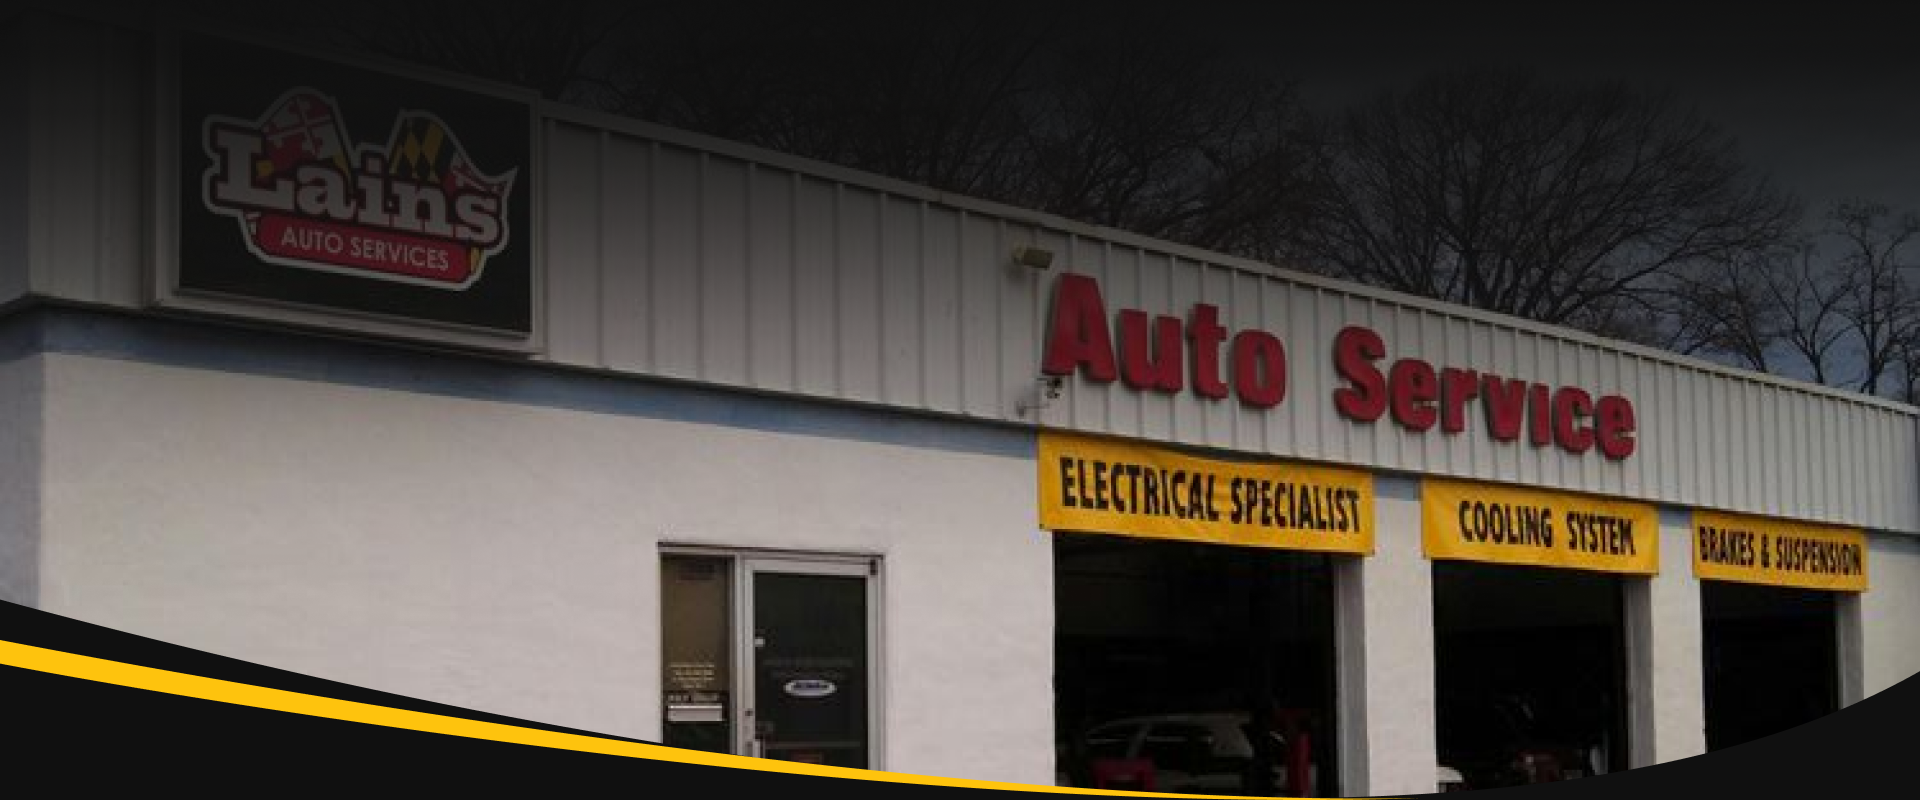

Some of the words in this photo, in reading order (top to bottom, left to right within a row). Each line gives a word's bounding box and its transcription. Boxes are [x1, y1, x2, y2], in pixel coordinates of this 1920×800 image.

[216, 129, 500, 244] Lains
[281, 226, 344, 254] AUTO
[350, 237, 450, 271] SERVICES
[1042, 273, 1287, 410] Auto
[1332, 326, 1636, 461] Service
[1059, 457, 1220, 522] ELECTRICAL
[1231, 477, 1360, 534] SPECIALIST
[1458, 500, 1552, 548] COOLING
[1566, 511, 1636, 556] SYSTEM
[1699, 526, 1754, 569] BRAKES
[1760, 533, 1770, 569] &
[1776, 534, 1862, 576] SUSPENSION
